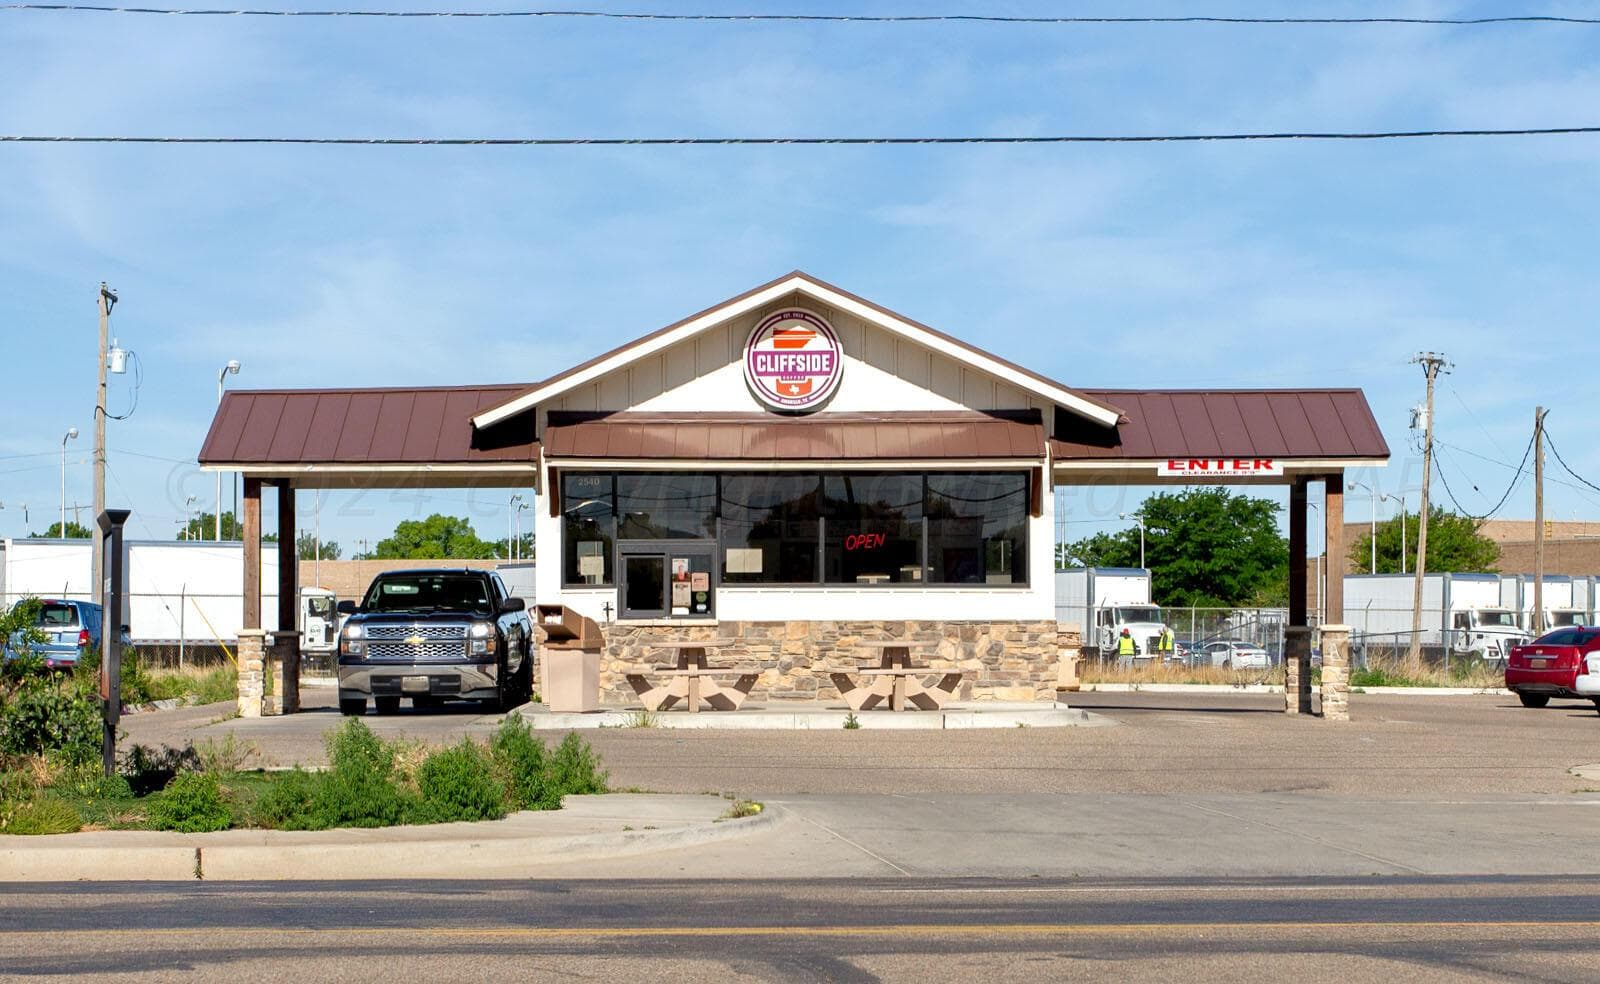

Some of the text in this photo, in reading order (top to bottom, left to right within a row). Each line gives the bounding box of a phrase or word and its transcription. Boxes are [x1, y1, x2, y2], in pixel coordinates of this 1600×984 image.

[756, 354, 831, 372] CLIFFSIDE
[1167, 459, 1273, 470] ENTER
[578, 477, 600, 486] 2540
[845, 533, 887, 551] OPEN
